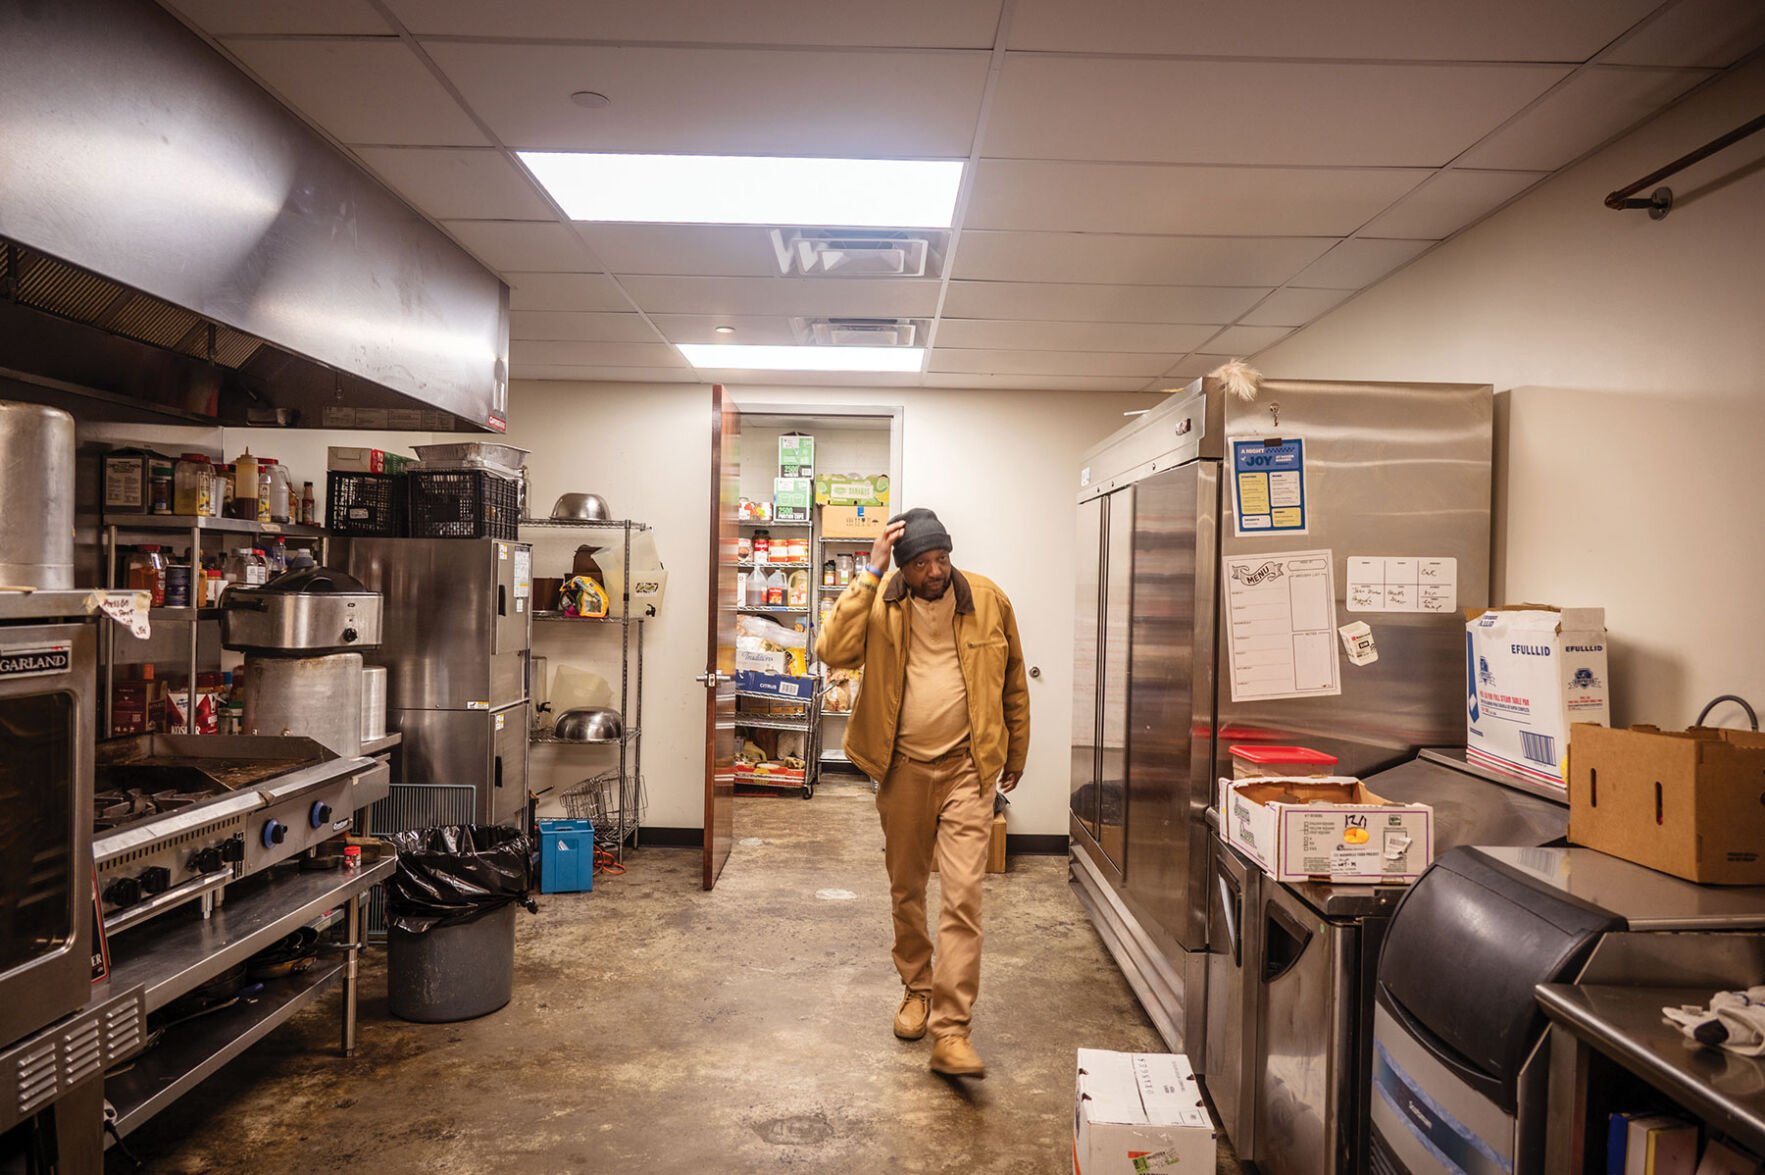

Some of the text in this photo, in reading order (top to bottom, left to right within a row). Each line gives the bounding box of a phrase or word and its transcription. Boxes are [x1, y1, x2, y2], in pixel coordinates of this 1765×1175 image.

[1247, 456, 1272, 467] JOY
[1246, 566, 1270, 584] MENU
[1511, 644, 1551, 657] EFULLLID
[0, 655, 66, 671] GARLAND
